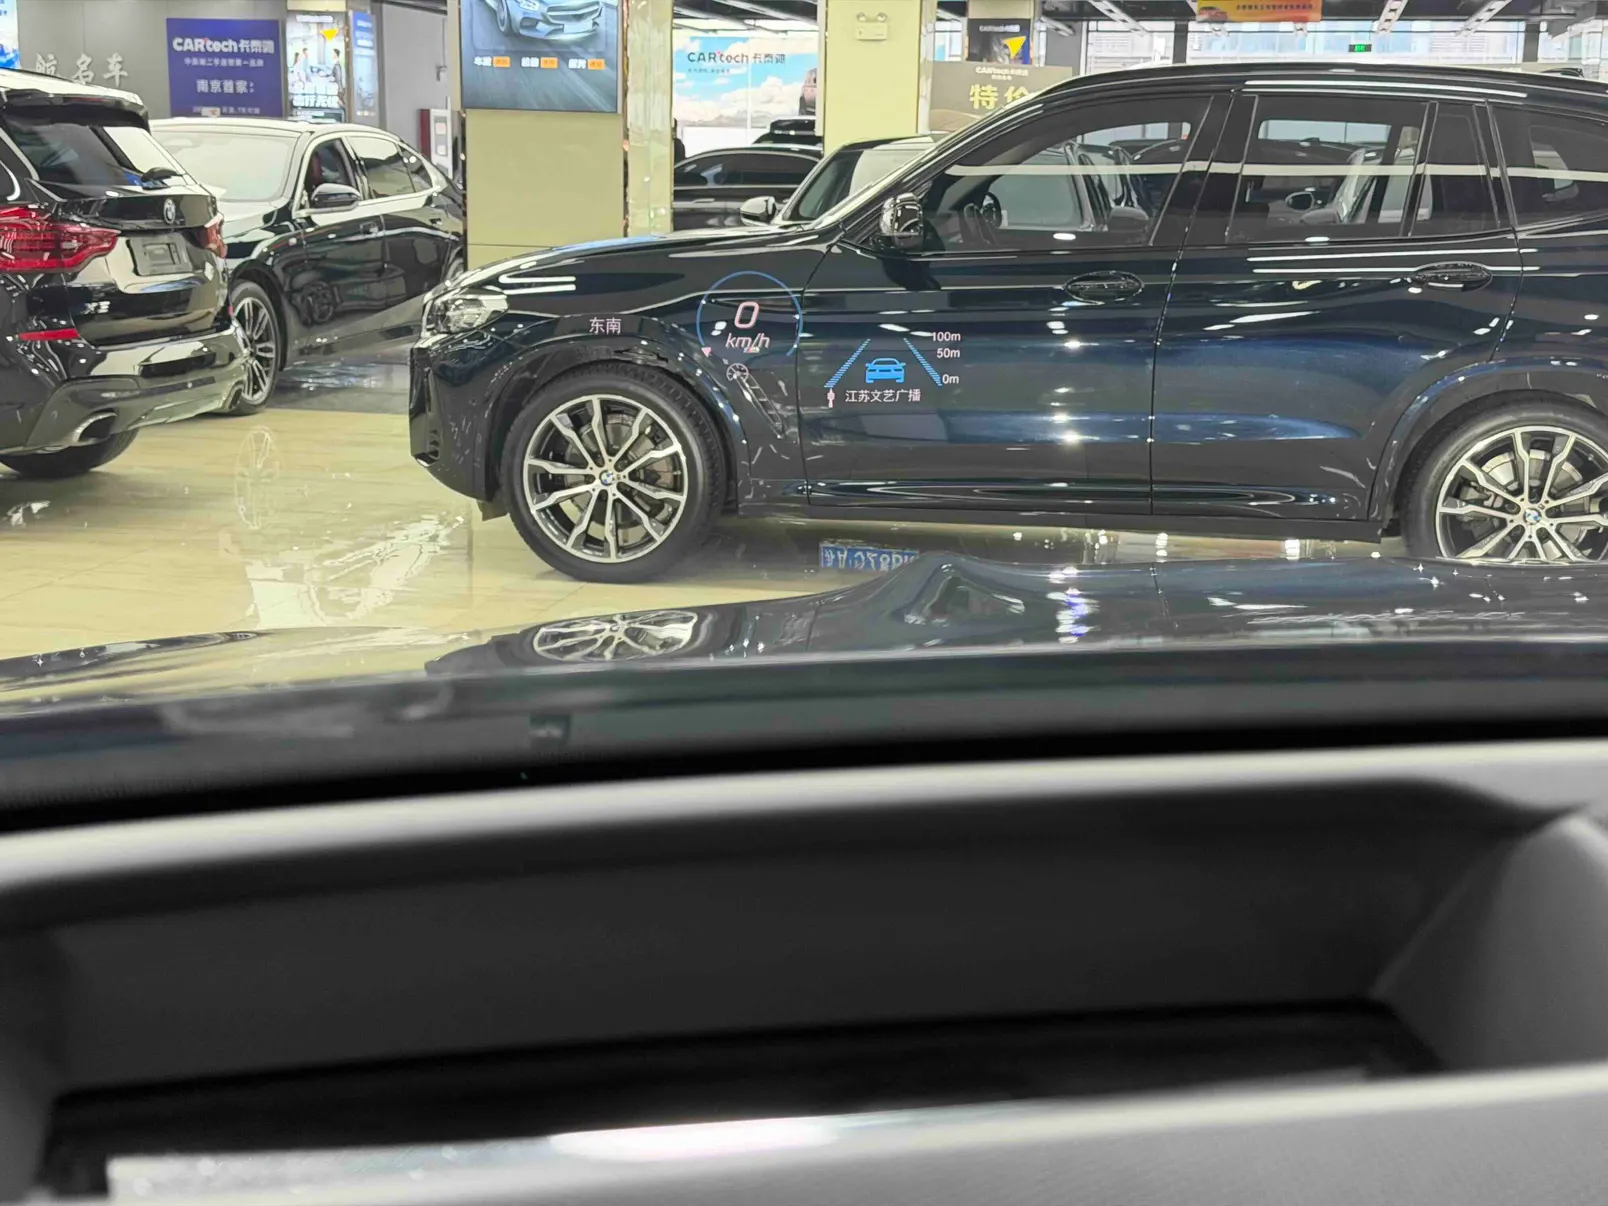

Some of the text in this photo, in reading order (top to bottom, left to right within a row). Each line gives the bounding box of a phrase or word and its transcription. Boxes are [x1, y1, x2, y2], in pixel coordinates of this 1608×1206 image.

[734, 301, 760, 329] 0
[589, 317, 622, 335] 东南
[725, 332, 771, 351] km/h
[931, 331, 961, 343] 100m
[936, 347, 961, 359] 50m
[942, 373, 960, 385] 0m
[844, 389, 922, 404] 江苏文艺广播
